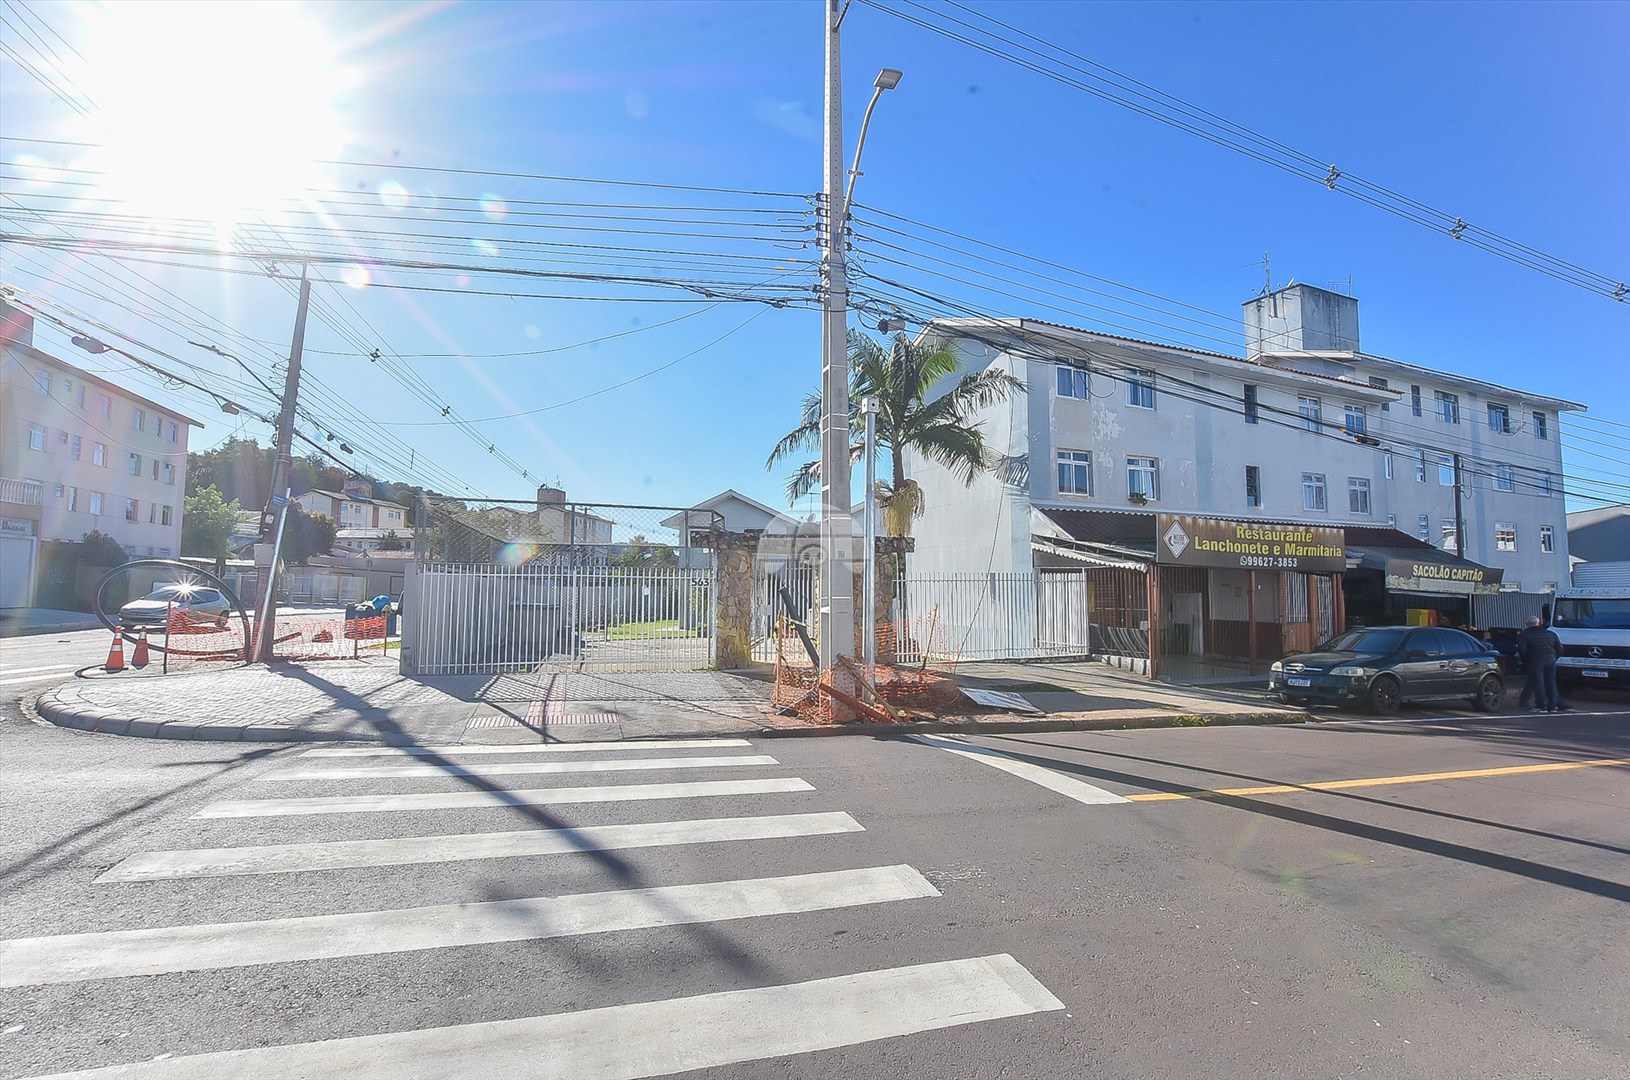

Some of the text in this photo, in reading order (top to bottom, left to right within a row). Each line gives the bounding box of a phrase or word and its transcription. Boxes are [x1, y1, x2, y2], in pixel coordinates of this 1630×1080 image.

[1236, 525, 1313, 543] Restaurante
[1194, 536, 1342, 557] Lanchonete e Marmitaria
[1247, 557, 1298, 568] 99627-3853
[1412, 564, 1484, 581] SACOLÃO CAPITÃO
[691, 577, 709, 586] 563
